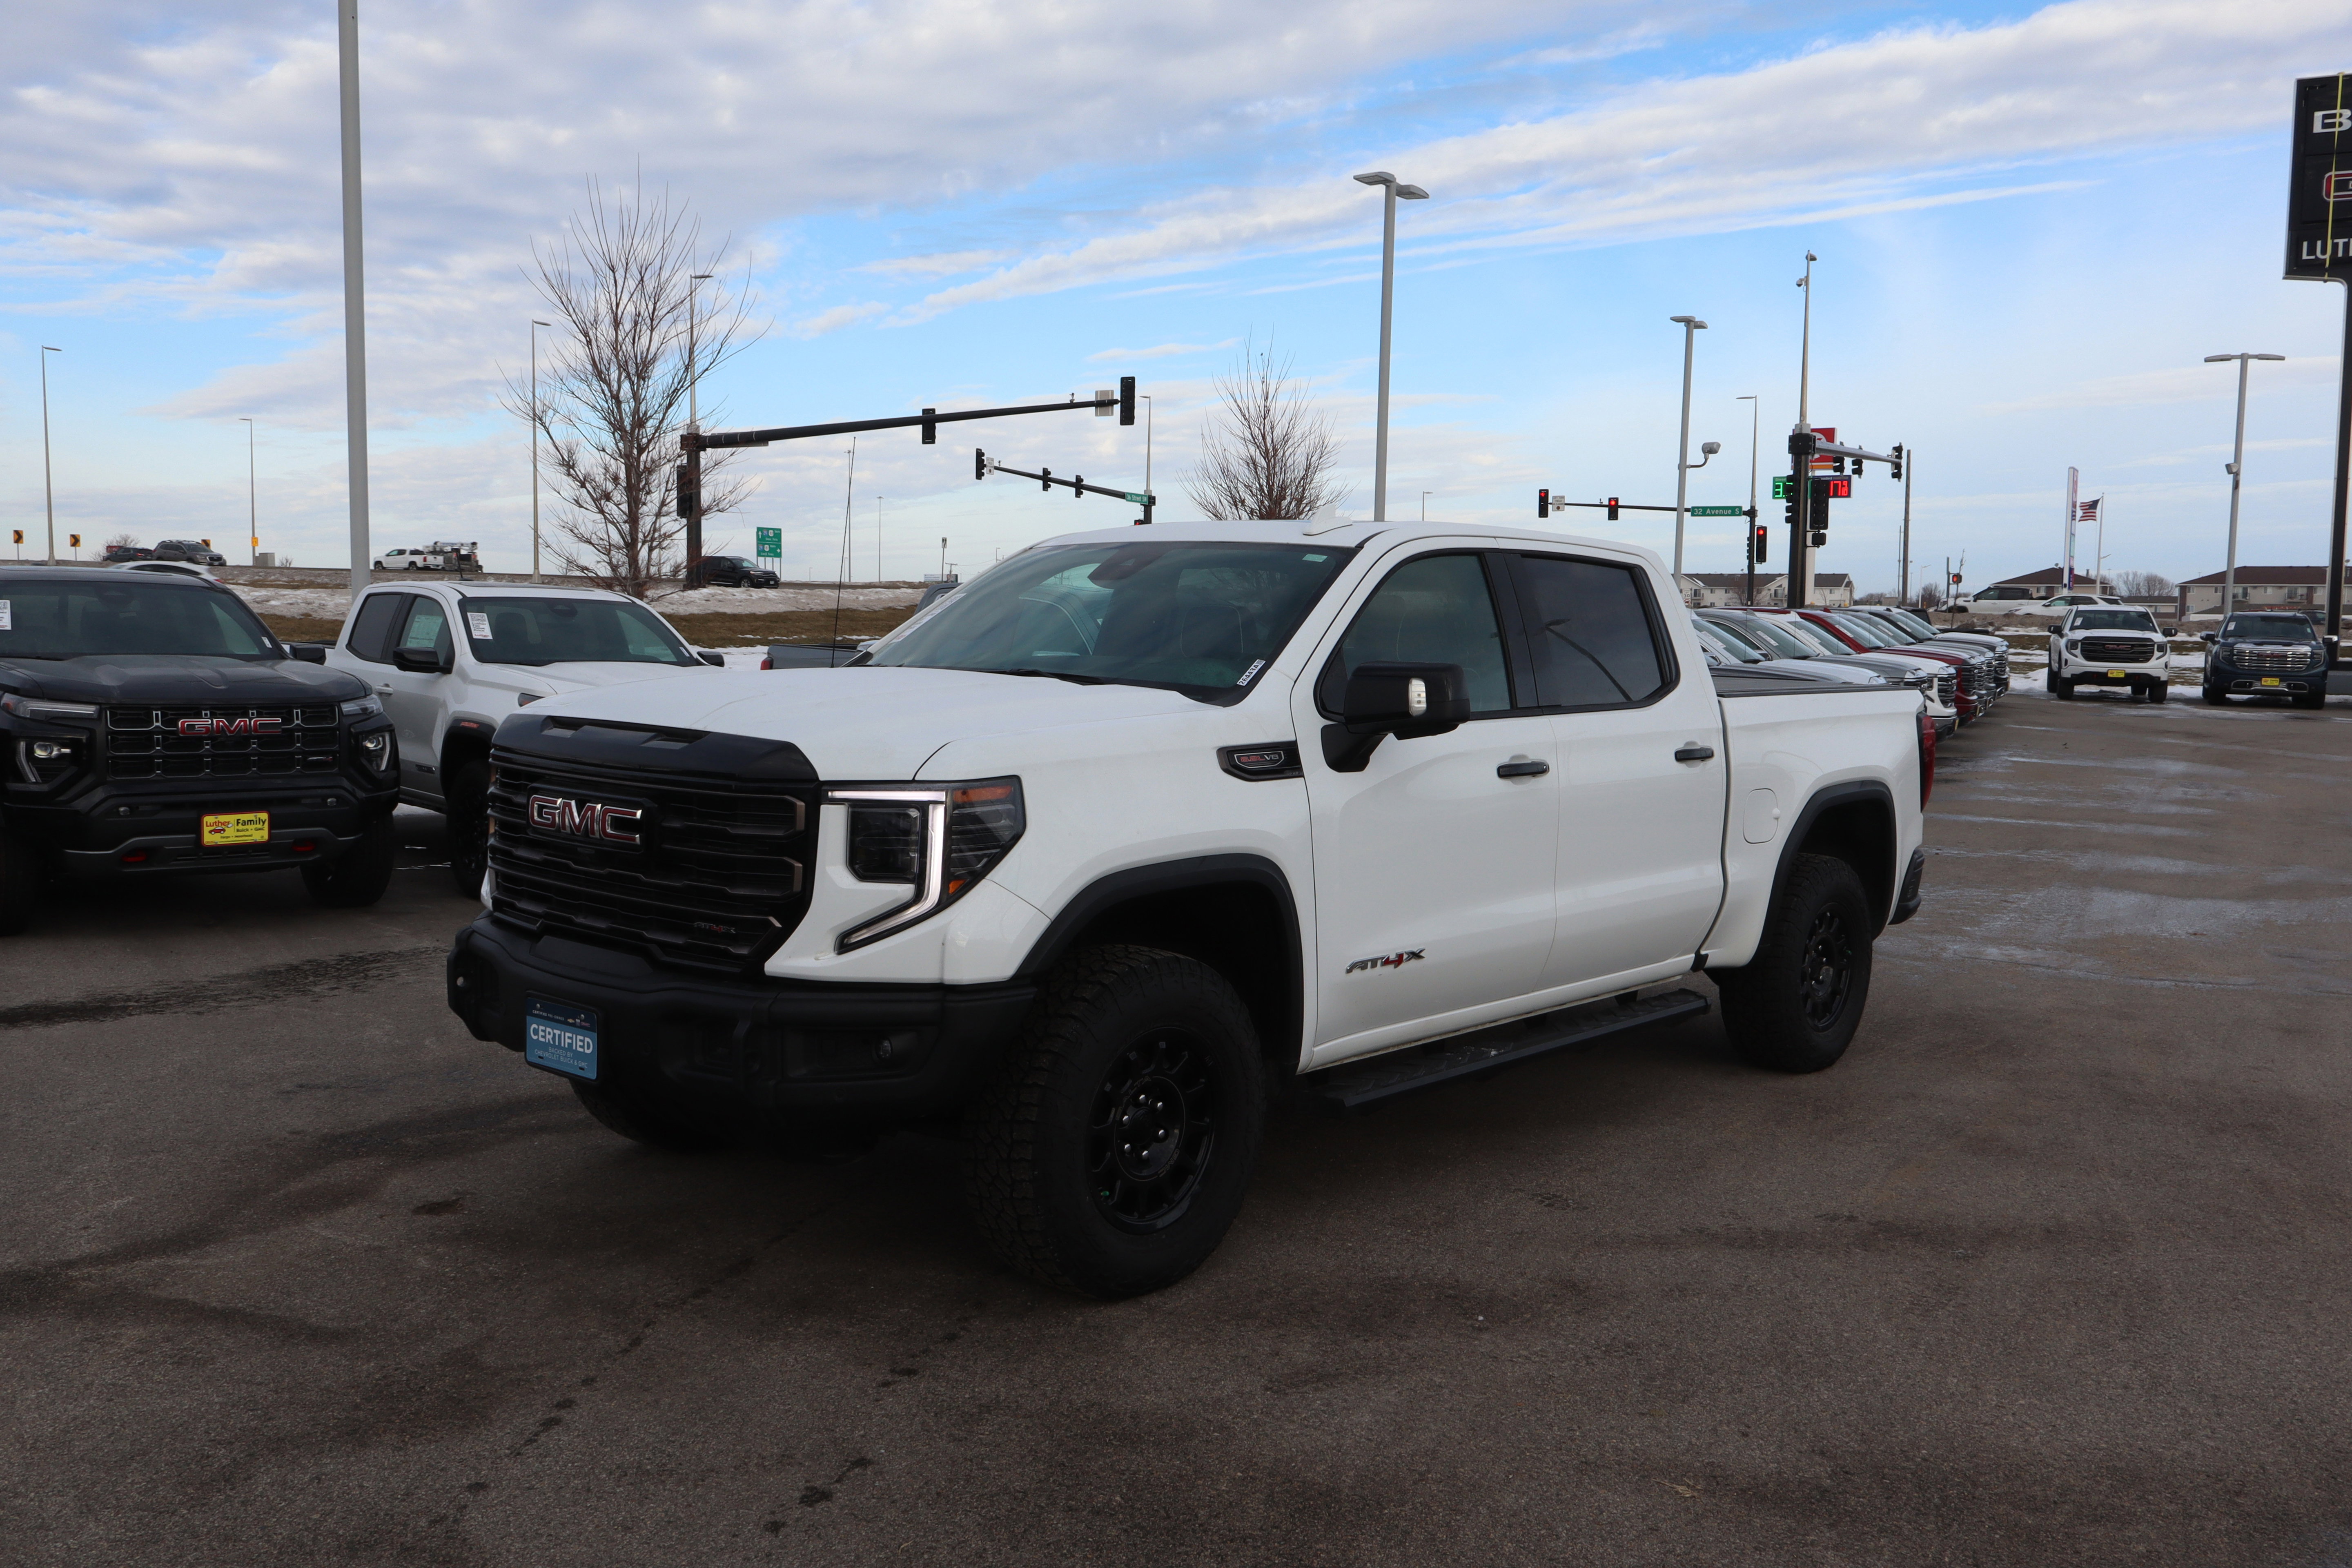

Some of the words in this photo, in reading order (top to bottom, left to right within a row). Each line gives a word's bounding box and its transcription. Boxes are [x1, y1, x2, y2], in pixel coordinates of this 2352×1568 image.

[2302, 238, 2352, 260] LUT
[179, 718, 281, 736] GMC
[236, 817, 266, 826] Family
[529, 795, 642, 845] GMC
[1345, 947, 1426, 974] AT4X
[530, 1024, 593, 1054] CERTIFIED
[535, 1049, 559, 1060] CHEVROLET
[560, 1056, 574, 1065] BUICK
[548, 1047, 566, 1056] BACKED
